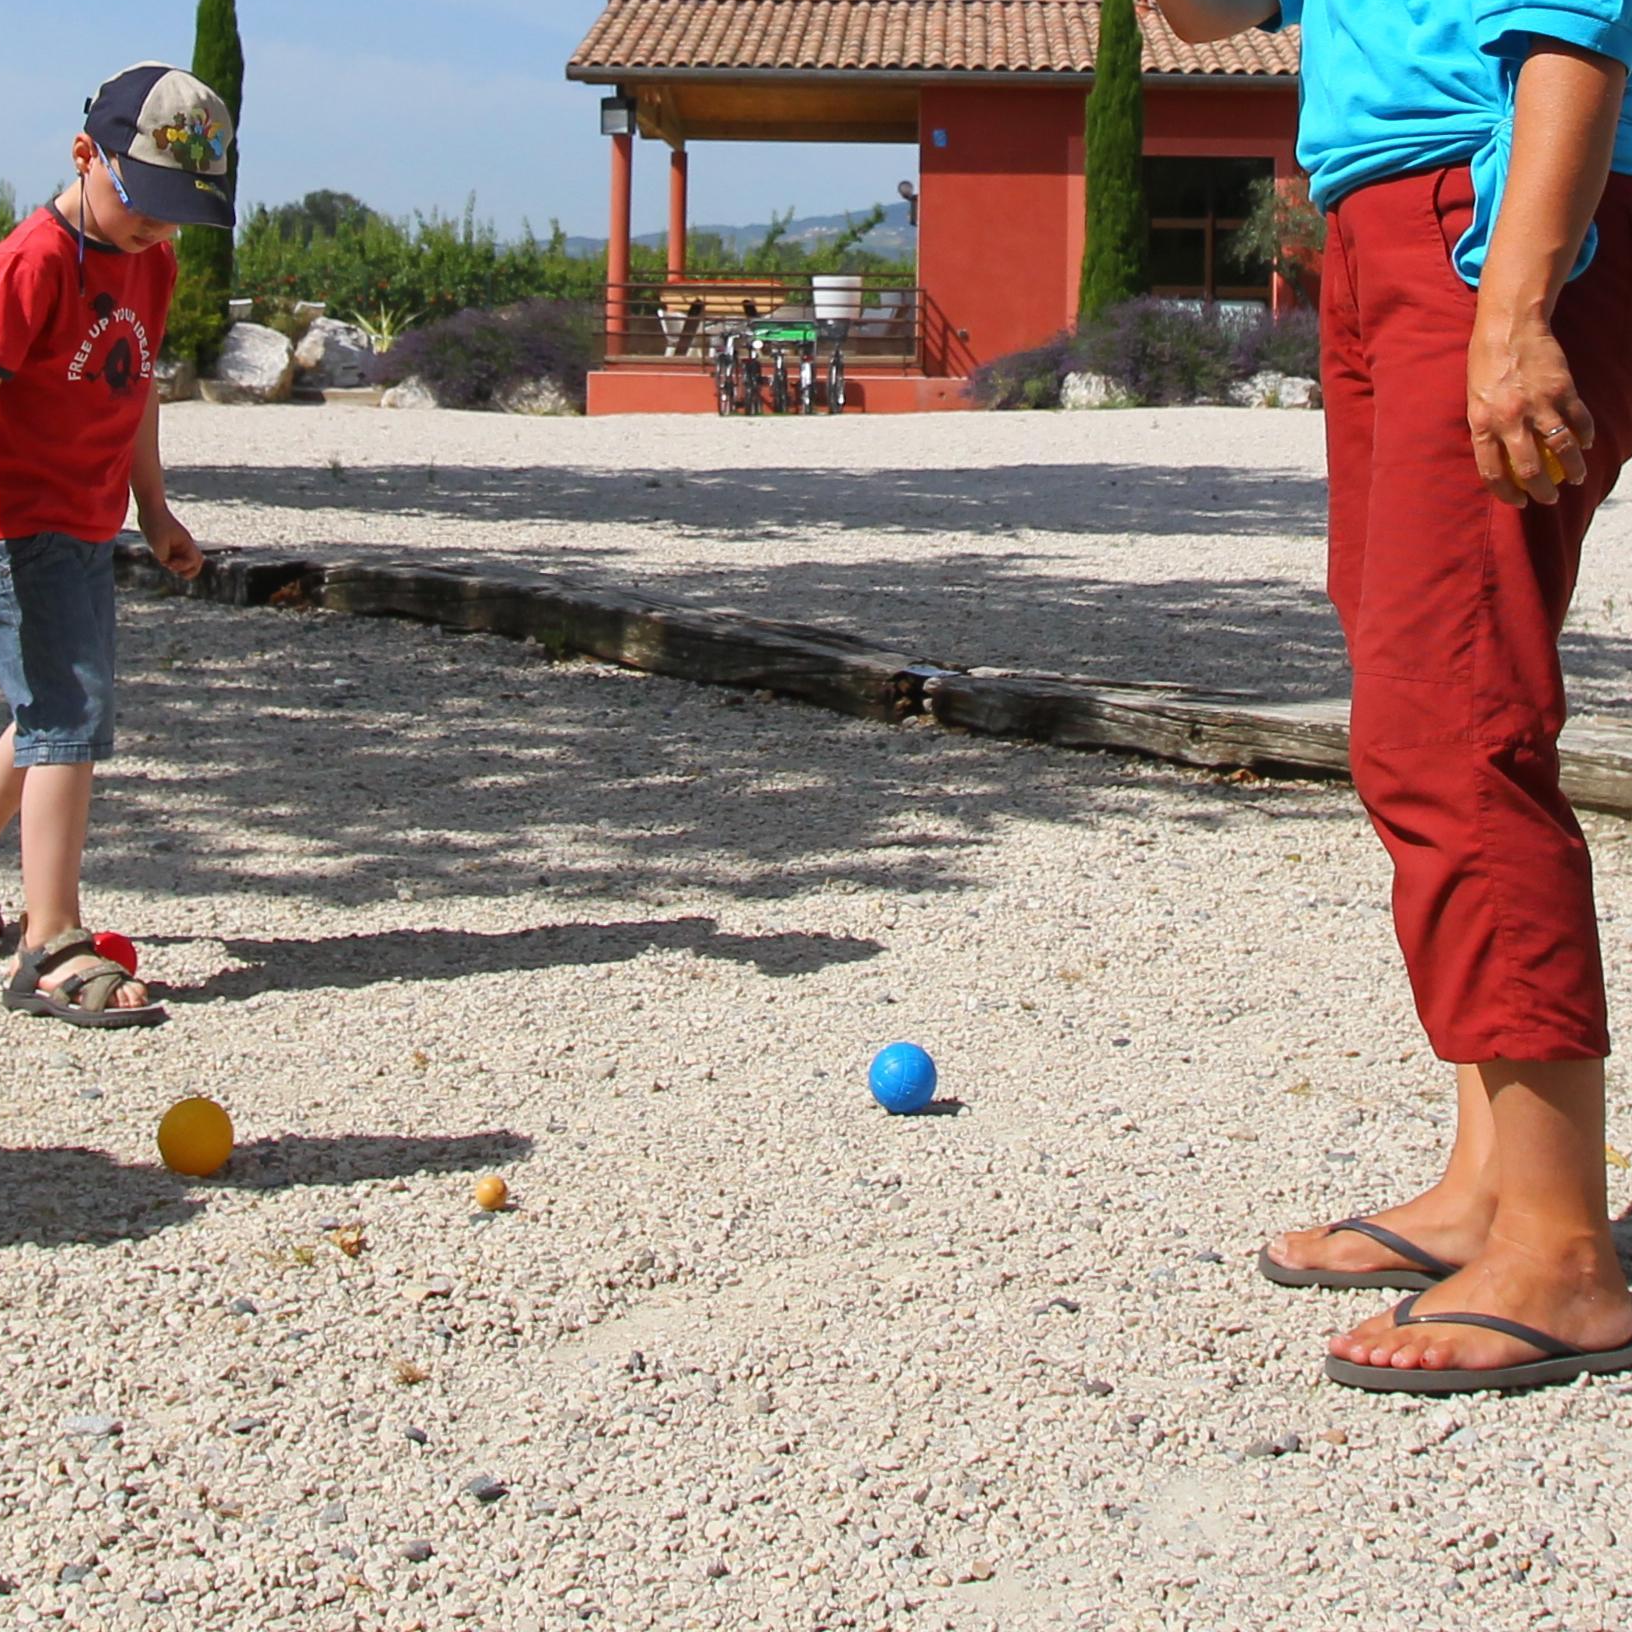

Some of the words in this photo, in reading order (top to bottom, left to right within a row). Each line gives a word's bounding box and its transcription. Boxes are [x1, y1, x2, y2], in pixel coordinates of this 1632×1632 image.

[68, 340, 92, 380] FREE
[89, 318, 108, 337] UP
[113, 308, 136, 324] YOUR
